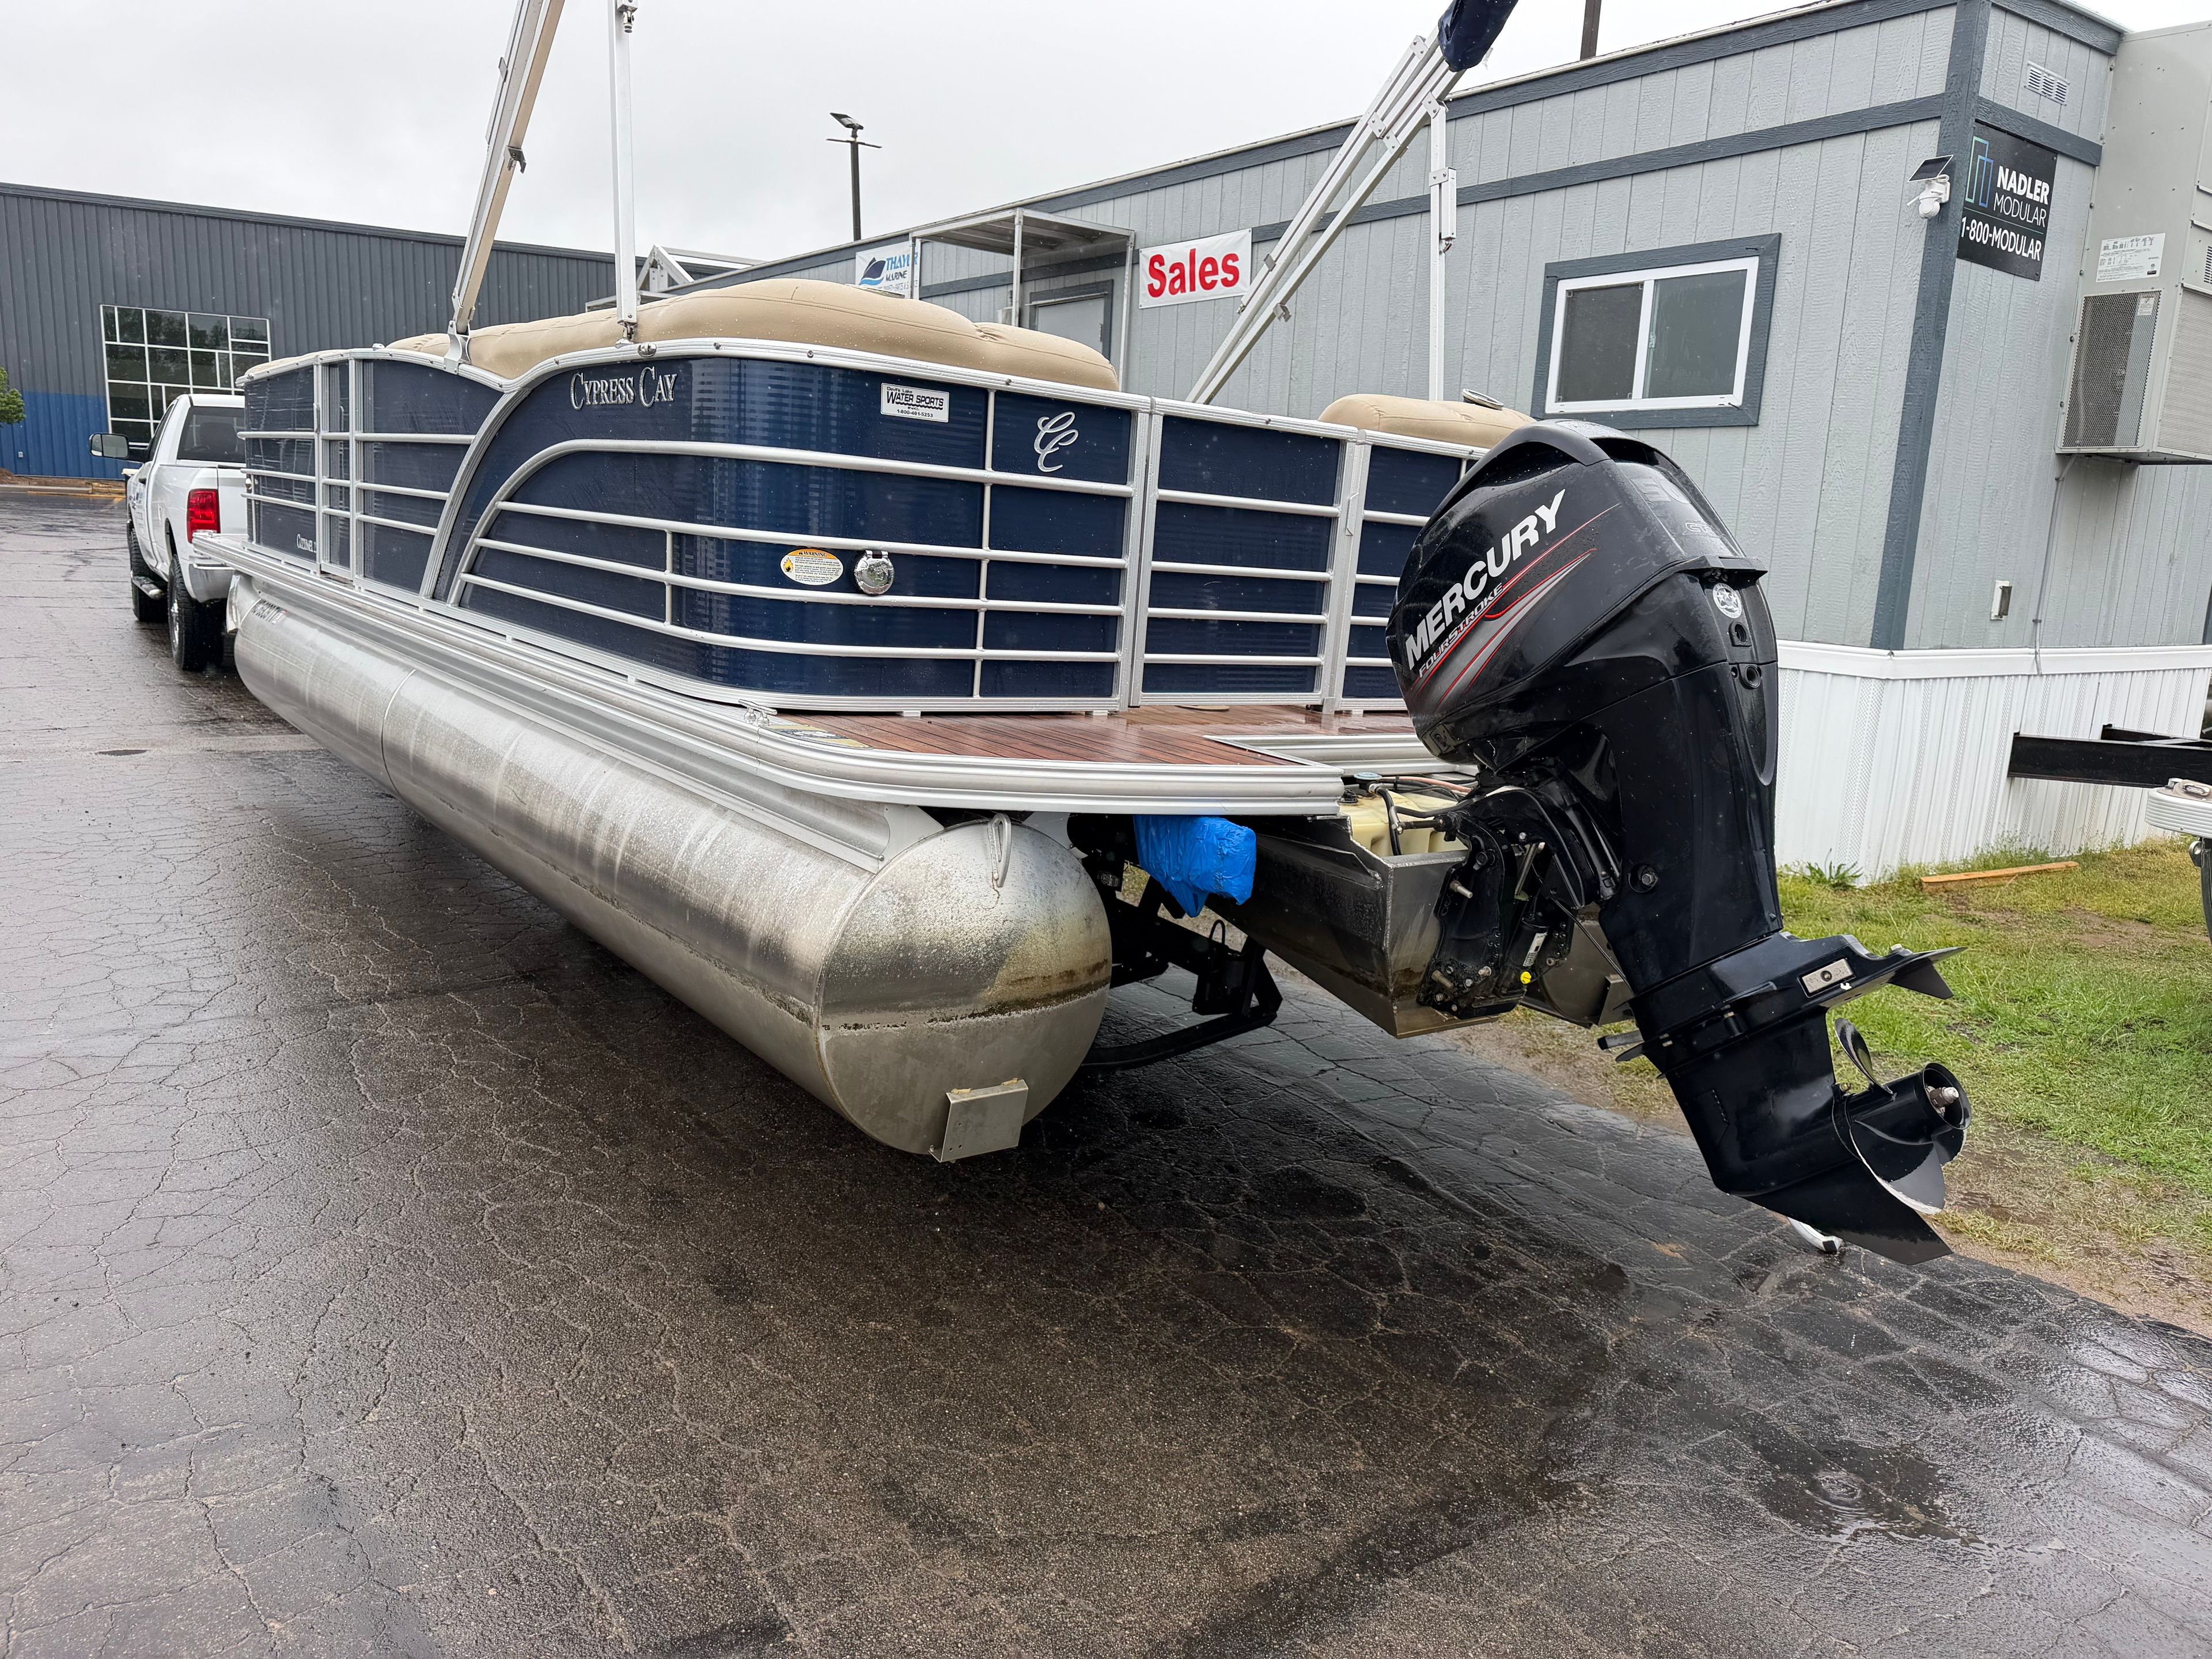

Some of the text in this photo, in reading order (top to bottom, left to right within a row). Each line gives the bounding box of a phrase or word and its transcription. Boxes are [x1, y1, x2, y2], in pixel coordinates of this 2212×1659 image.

[1997, 166, 2050, 204] NADLER
[1994, 192, 2047, 228] MODULAR
[1961, 217, 2042, 261] 1-800-MODULAR
[1147, 248, 1240, 298] Sales
[570, 366, 677, 411] CYPRESS CAY
[887, 391, 944, 406] WATER SPORTS
[1405, 488, 1566, 671] MERCURY
[1419, 582, 1503, 679] FOURSTROKE
